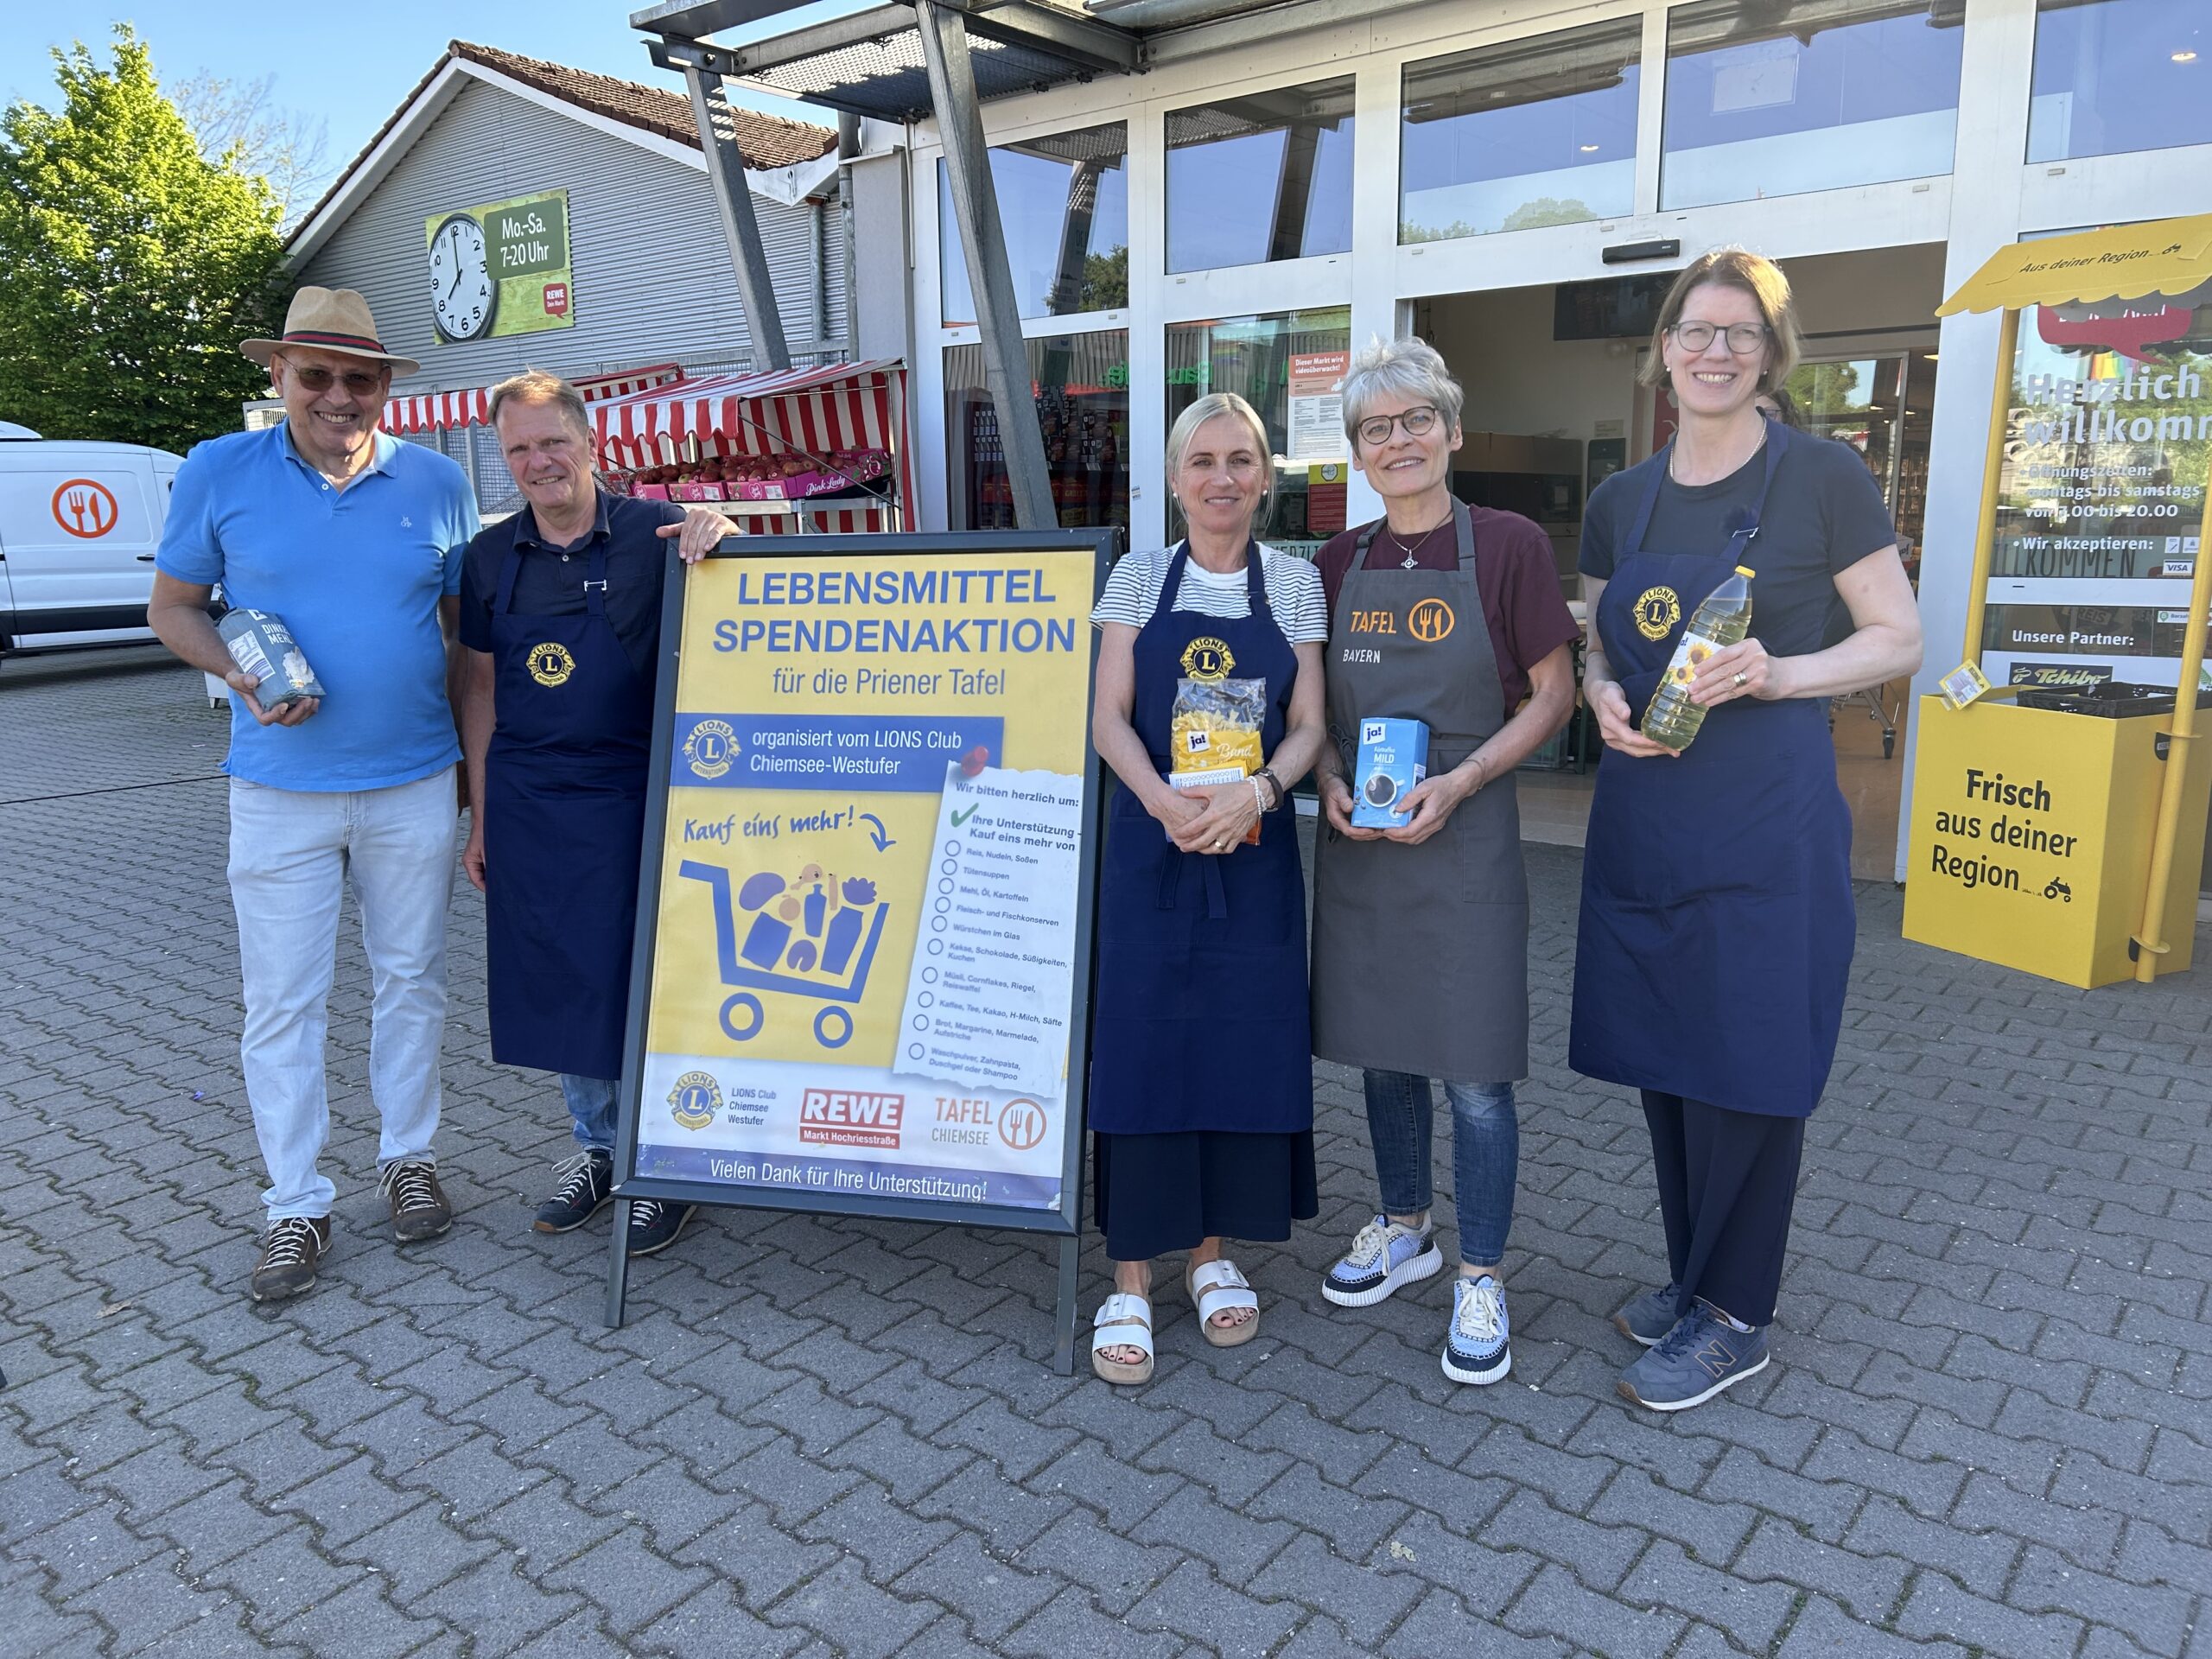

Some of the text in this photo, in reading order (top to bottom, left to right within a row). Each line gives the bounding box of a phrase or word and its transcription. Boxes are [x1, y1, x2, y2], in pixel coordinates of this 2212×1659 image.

[502, 213, 546, 239] Mo.-Sa.
[473, 240, 480, 251] 2
[528, 240, 550, 263] Uhr
[434, 255, 442, 267] 10
[480, 261, 487, 273] 3
[2019, 249, 2149, 274] Aus deiner Region
[432, 278, 439, 290] 9
[480, 285, 487, 297] 4
[546, 289, 564, 300] REWE
[439, 300, 446, 312] 8
[473, 306, 480, 320] 5
[448, 315, 454, 328] 7
[461, 317, 469, 331] 6
[2026, 364, 2201, 406] Herzlich
[806, 475, 846, 496] Pink Lady
[2098, 485, 2120, 497] bis
[2125, 485, 2201, 499] samstags
[2098, 505, 2122, 517] bis
[2126, 505, 2178, 518] 20.00
[2023, 537, 2153, 552] Wir akzeptieren:
[737, 569, 1057, 605] LEBENSMITTEL
[1648, 588, 1675, 601] LIONS
[1650, 603, 1662, 622] L
[1351, 611, 1397, 634] TAFEL
[267, 633, 293, 645] MEHL
[712, 618, 1075, 653] SPENDENAKTION
[2012, 630, 2134, 646] Unsere Partner:
[537, 645, 563, 654] LIONS
[1194, 639, 1224, 651] LIONS
[545, 657, 557, 671] L
[1202, 652, 1216, 670] L
[1342, 649, 1381, 664] BAYERN
[773, 668, 1005, 696] für die Priener Tafel
[696, 721, 731, 734] LIONS
[1366, 726, 1382, 741] ja!
[752, 729, 962, 750] organisiert vom LIONS Club
[1190, 734, 1206, 749] ja!
[704, 738, 720, 759] L
[750, 755, 900, 775] Chiemsee-Westufer
[1374, 753, 1395, 764] MILD
[956, 782, 1079, 807] Wir bitten herzlich um:
[1967, 769, 2050, 812] Frisch
[683, 804, 854, 845] Kauf eins mehr!
[972, 814, 994, 826] Ihre
[996, 817, 1075, 839] Unterstützung
[969, 828, 1076, 851] Kauf eins mehr von
[1936, 810, 2077, 858] aus deiner
[966, 848, 1039, 865] Reis, Nudeln, Soßen
[963, 867, 1010, 880] Tütensuppen
[1932, 844, 2019, 892] Region
[960, 886, 979, 896] Mehl,
[993, 891, 1029, 903] Kartoffeln
[957, 904, 1059, 927] Fleisch- und Fischkonserven
[953, 923, 992, 936] Würstchen
[1004, 931, 1020, 941] Glas
[947, 952, 976, 963] Kuchen
[976, 946, 1020, 962] Schokolade,
[1021, 954, 1068, 969] Süßigkeiten,
[967, 975, 1009, 989] Cornflakes,
[1011, 982, 1036, 994] Riegel,
[982, 1007, 1008, 1019] Kakao,
[1009, 1011, 1040, 1024] H-Milch,
[1042, 1016, 1063, 1027] Säfte
[955, 1021, 995, 1037] Margarine,
[995, 1028, 1039, 1044] Marmelade,
[929, 1058, 1018, 1081] Duschgel oder Shampoo
[980, 1055, 1021, 1071] Zahnpasta,
[681, 1073, 715, 1087] LIONS
[689, 1090, 702, 1109] L
[731, 1088, 777, 1099] LIONS Club
[729, 1101, 769, 1112] Chiemsee
[804, 1092, 900, 1126] REWE
[935, 1097, 994, 1125] TAFEL
[728, 1114, 765, 1126] Westufer
[804, 1129, 896, 1146] Markt Hochriesstraße
[931, 1127, 989, 1146] CHIEMSEE
[709, 1159, 988, 1200] Vielen Dank für Ihre Unterstützung!
